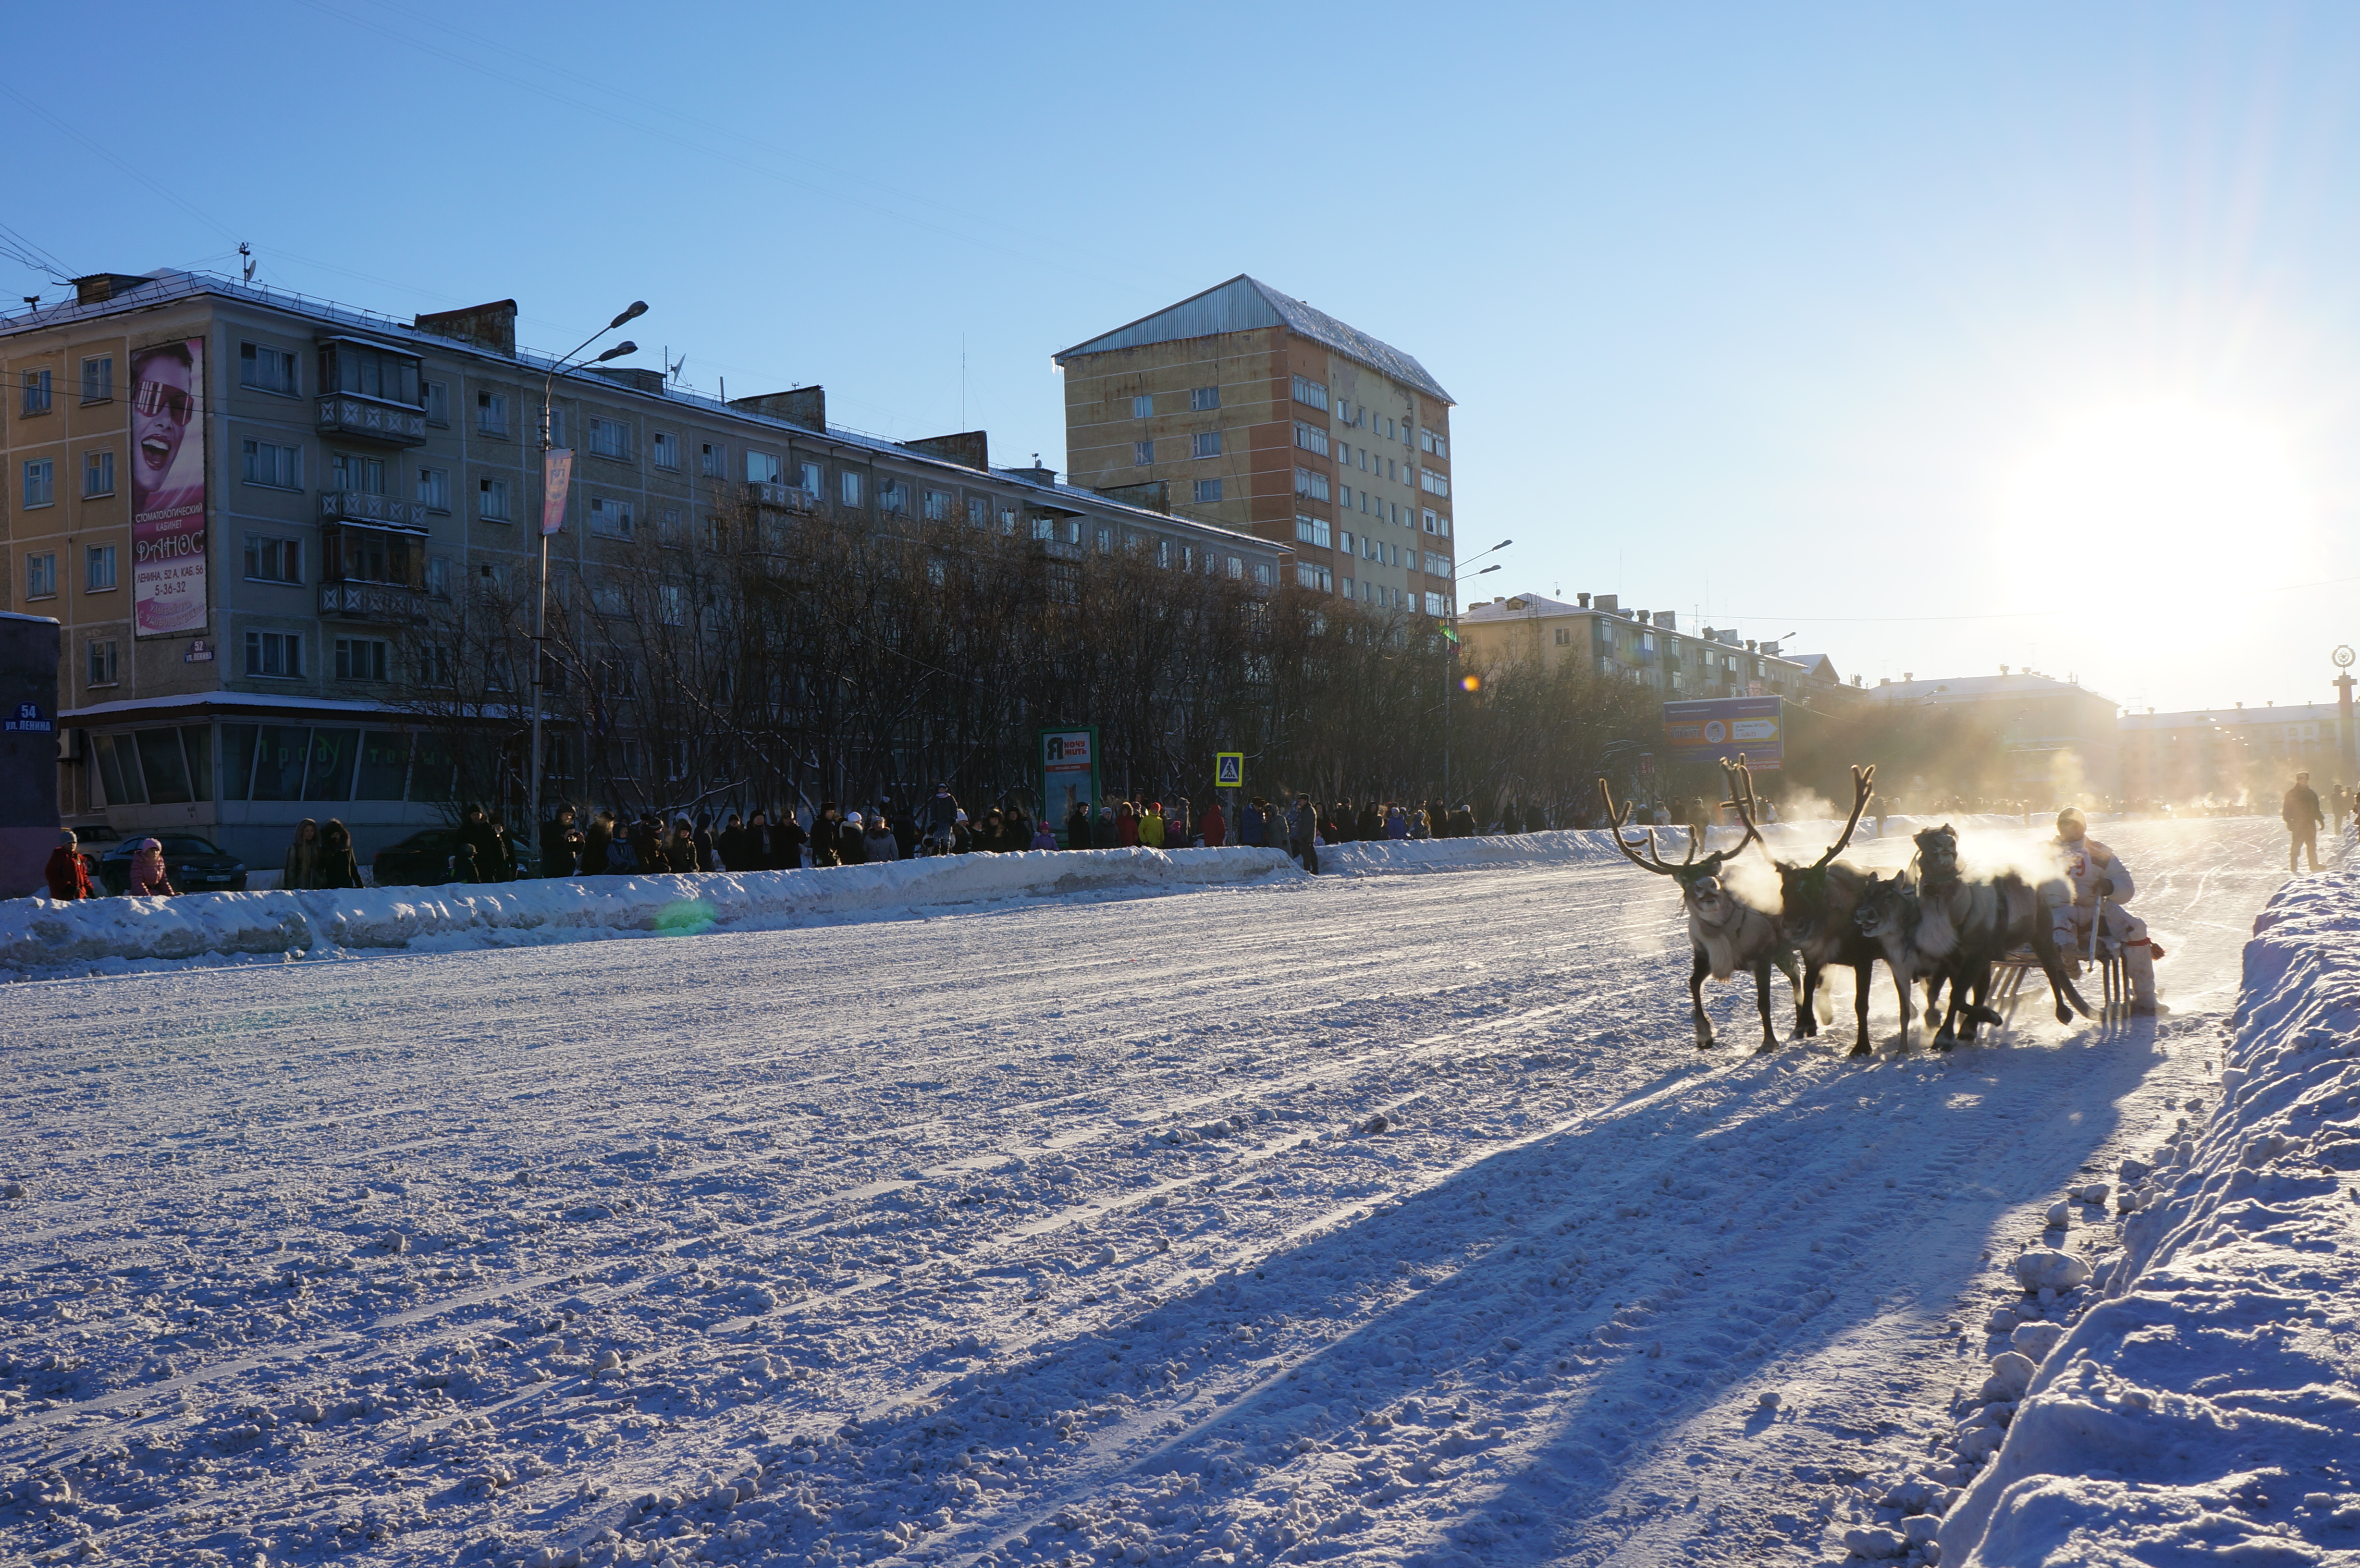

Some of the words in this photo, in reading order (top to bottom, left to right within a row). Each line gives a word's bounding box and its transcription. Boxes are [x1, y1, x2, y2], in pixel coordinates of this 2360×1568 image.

[135, 502, 203, 523] СТОМАТОЛОГИЧЕСКИЙ
[156, 519, 183, 532] КАБИНЕТ
[136, 530, 204, 564] ДАНОС
[136, 571, 162, 583] ЛЕНИНА,
[164, 569, 172, 579] 52
[181, 566, 195, 577] КАБ.
[195, 564, 204, 575] 56
[155, 581, 186, 596] 5-36-32
[194, 641, 203, 651] 52
[21, 705, 36, 718] 54
[19, 720, 50, 731] ЛЕНИНА
[1047, 737, 1064, 760] Я
